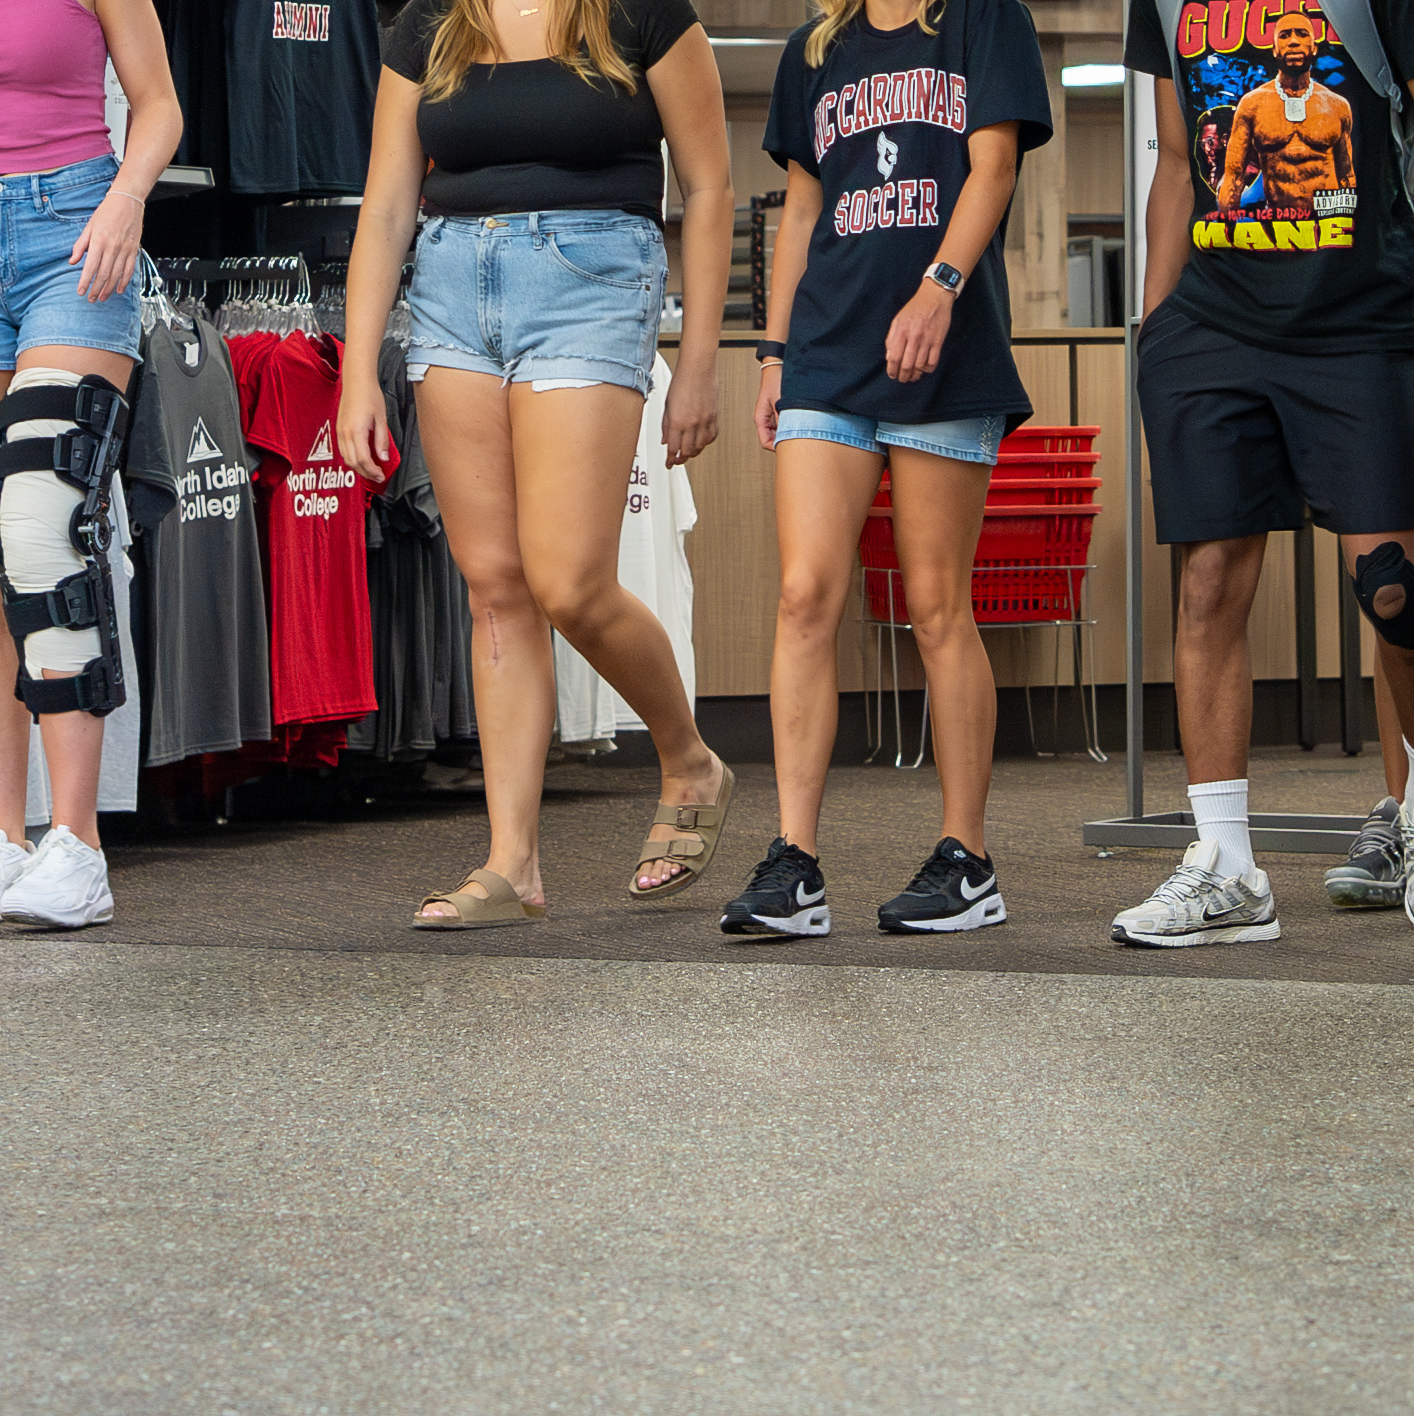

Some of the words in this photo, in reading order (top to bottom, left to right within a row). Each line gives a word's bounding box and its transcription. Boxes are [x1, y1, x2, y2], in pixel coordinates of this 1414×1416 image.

[834, 178, 939, 237] SOCCER
[1256, 208, 1273, 220] ICE
[1276, 208, 1311, 220] DADDY
[1317, 197, 1355, 209] ADVISORY
[1192, 217, 1356, 252] MANE
[319, 466, 355, 490] Idaho
[294, 492, 339, 521] College
